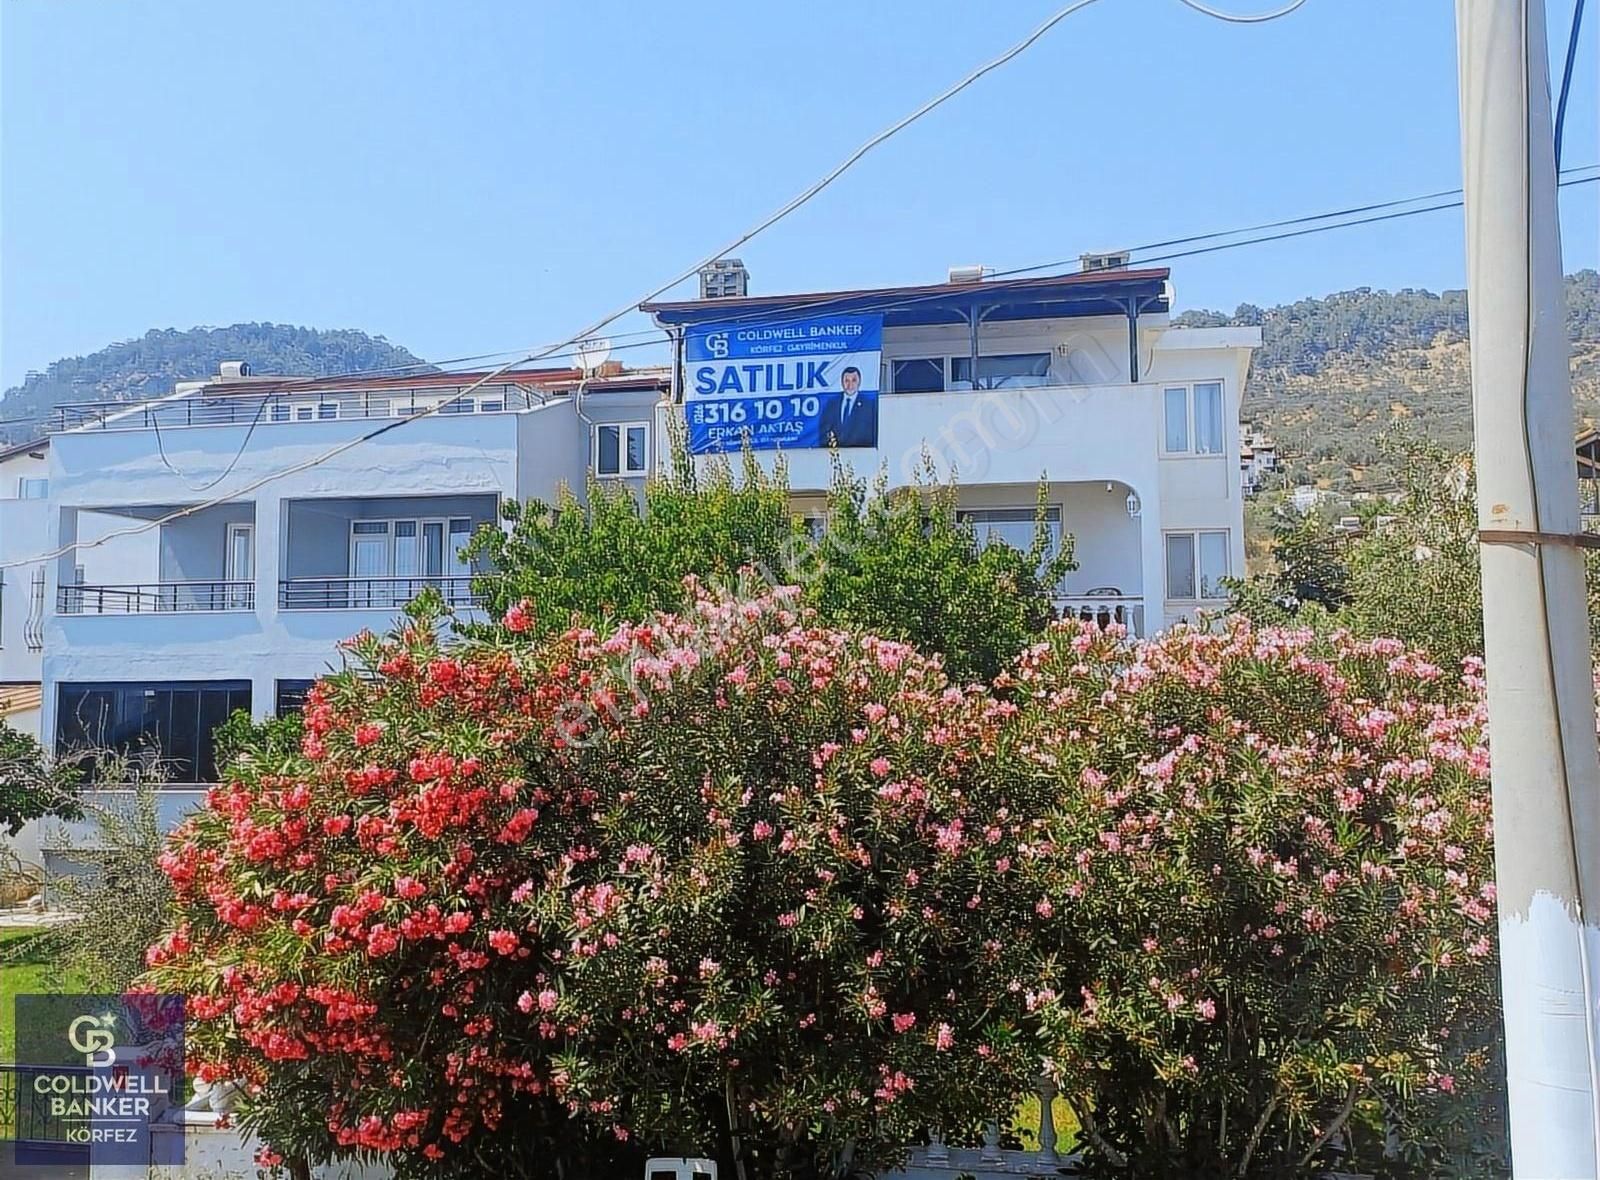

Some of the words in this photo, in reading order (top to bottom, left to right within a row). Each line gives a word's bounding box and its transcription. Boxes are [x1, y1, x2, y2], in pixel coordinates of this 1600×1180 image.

[737, 327, 806, 341] COLDWELL
[810, 325, 862, 337] BANKER
[750, 344, 783, 354] KÖRFEZ
[695, 361, 832, 395] SATILIK
[704, 401, 747, 424] 316
[754, 399, 783, 419] 10
[790, 396, 820, 417] 10
[708, 424, 754, 439] ERKAN
[759, 421, 804, 435] AKTAŞ
